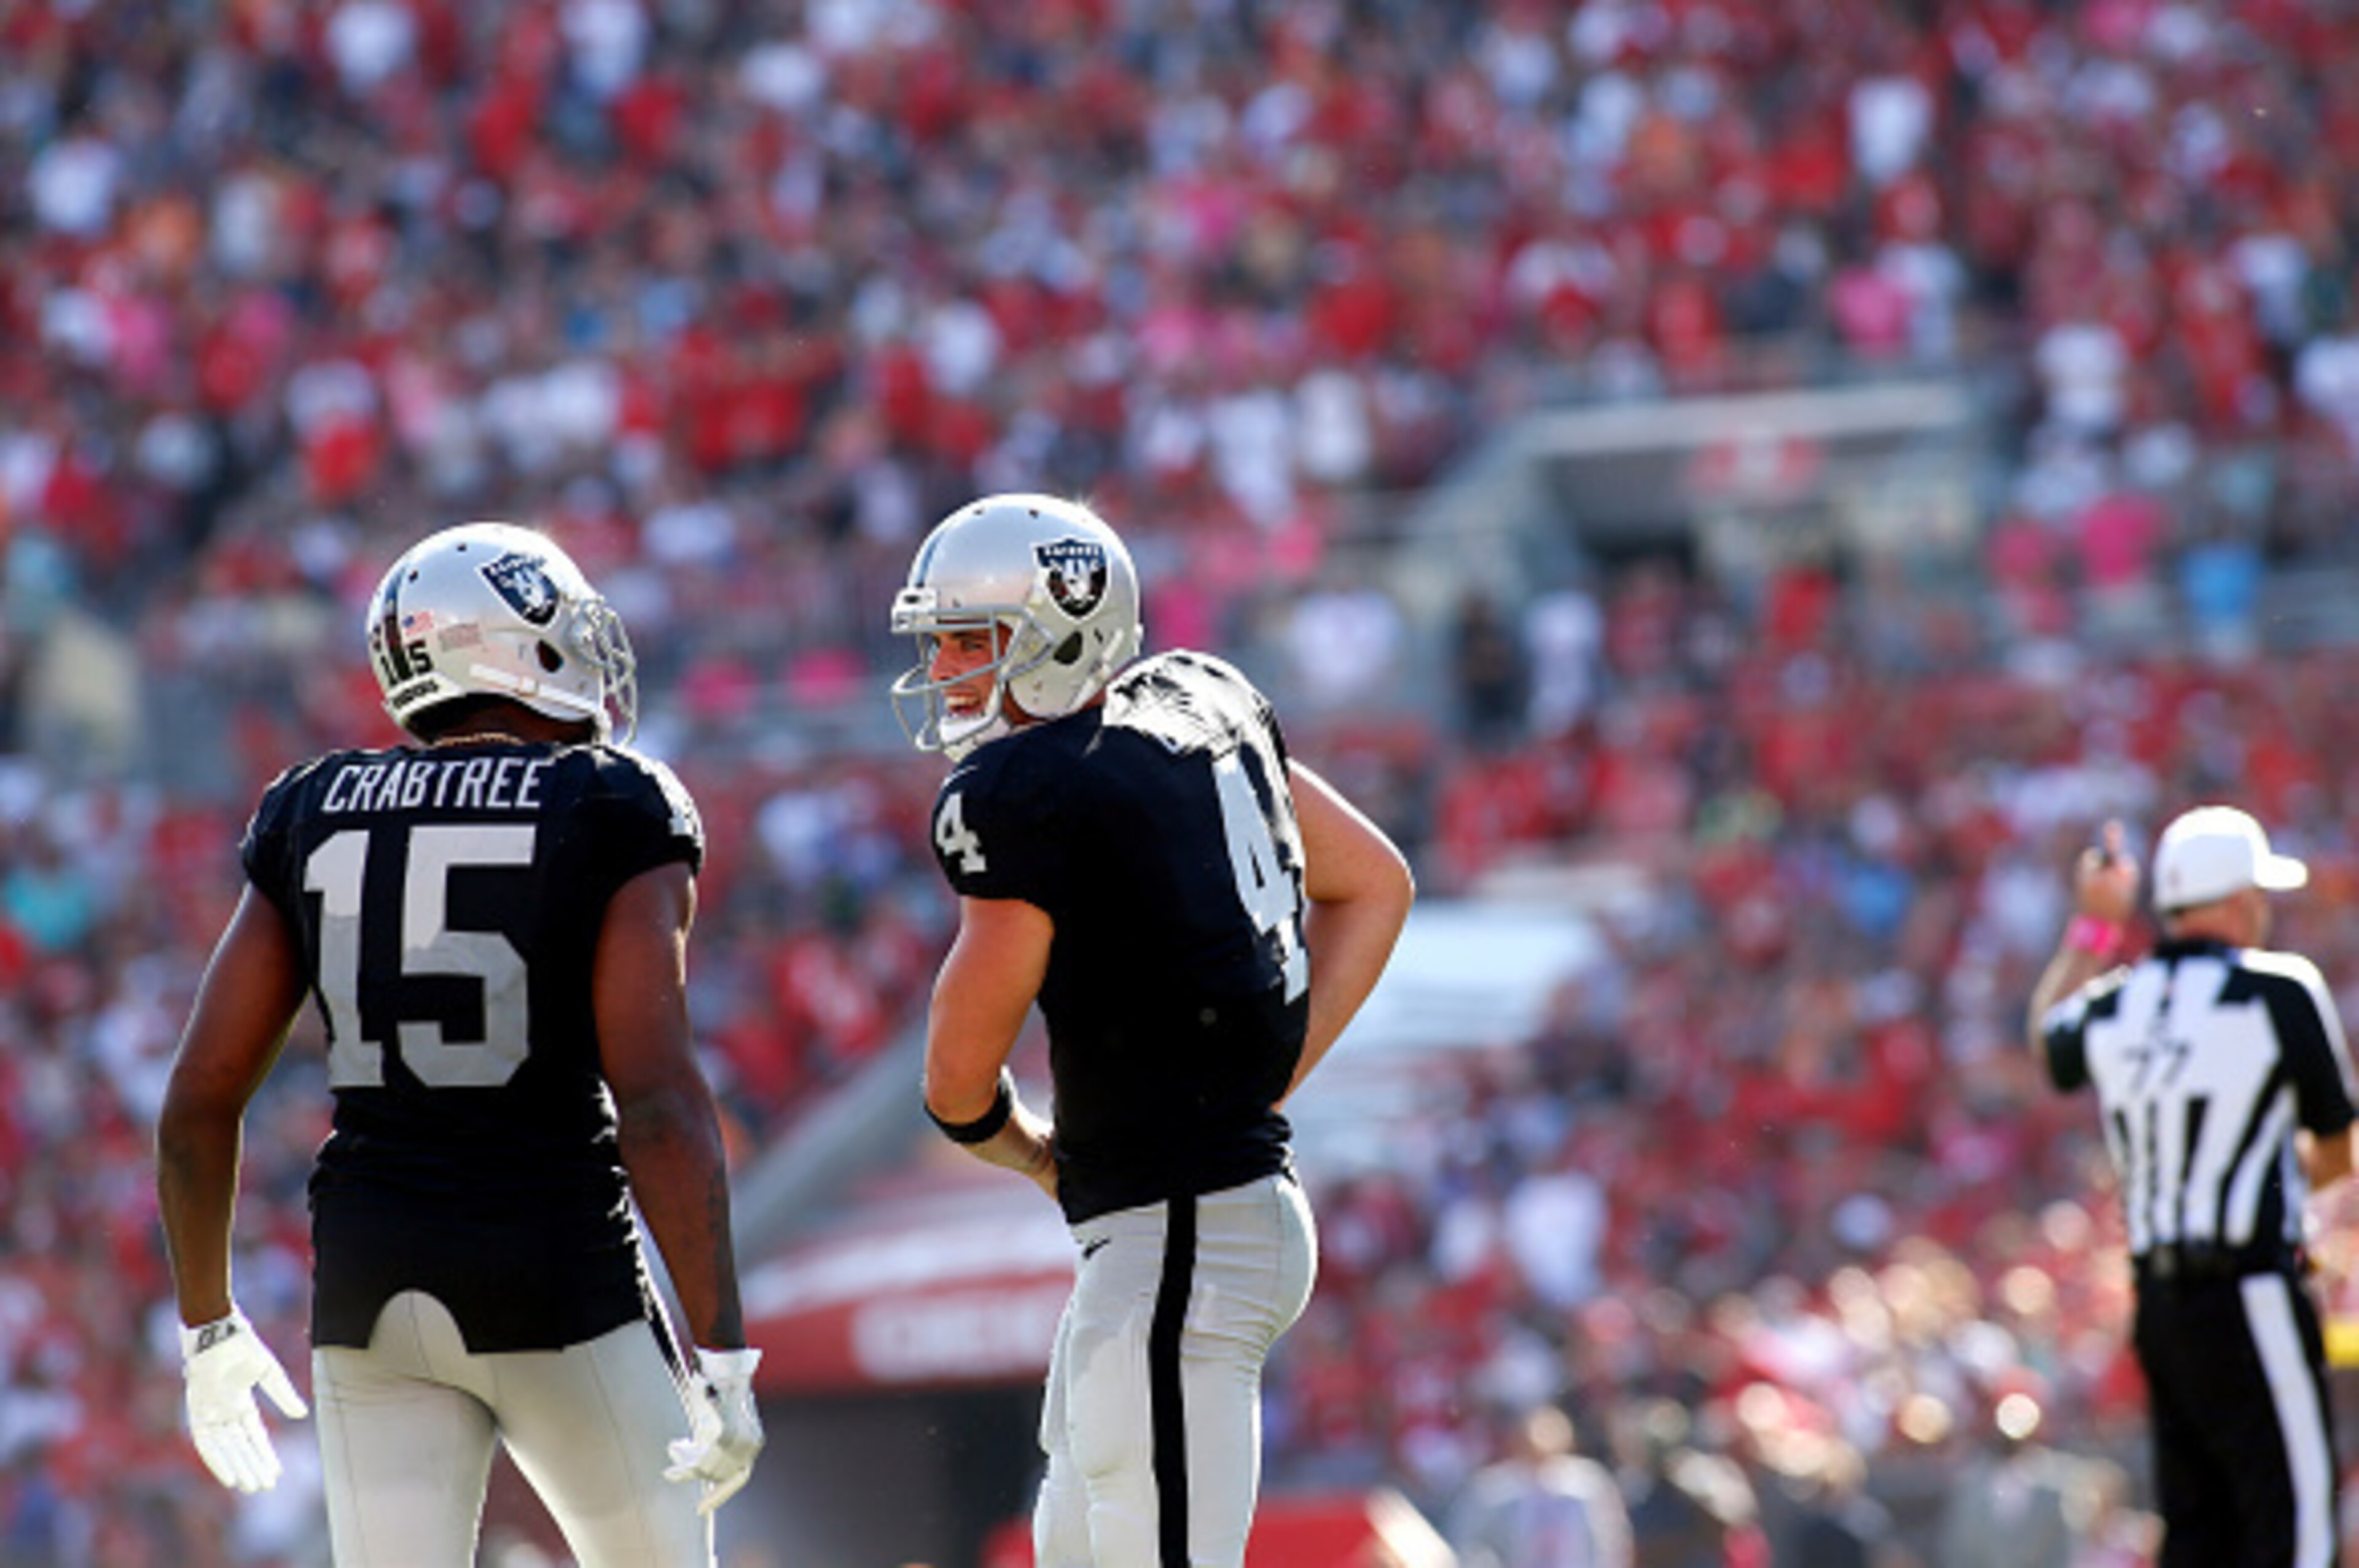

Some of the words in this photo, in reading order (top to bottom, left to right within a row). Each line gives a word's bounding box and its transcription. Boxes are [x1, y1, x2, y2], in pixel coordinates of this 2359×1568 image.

[320, 757, 553, 815] CRABTREE
[936, 792, 987, 873] 4
[1213, 751, 1310, 1006] 4
[303, 824, 536, 1089] 15
[2122, 1041, 2194, 1093] 77
